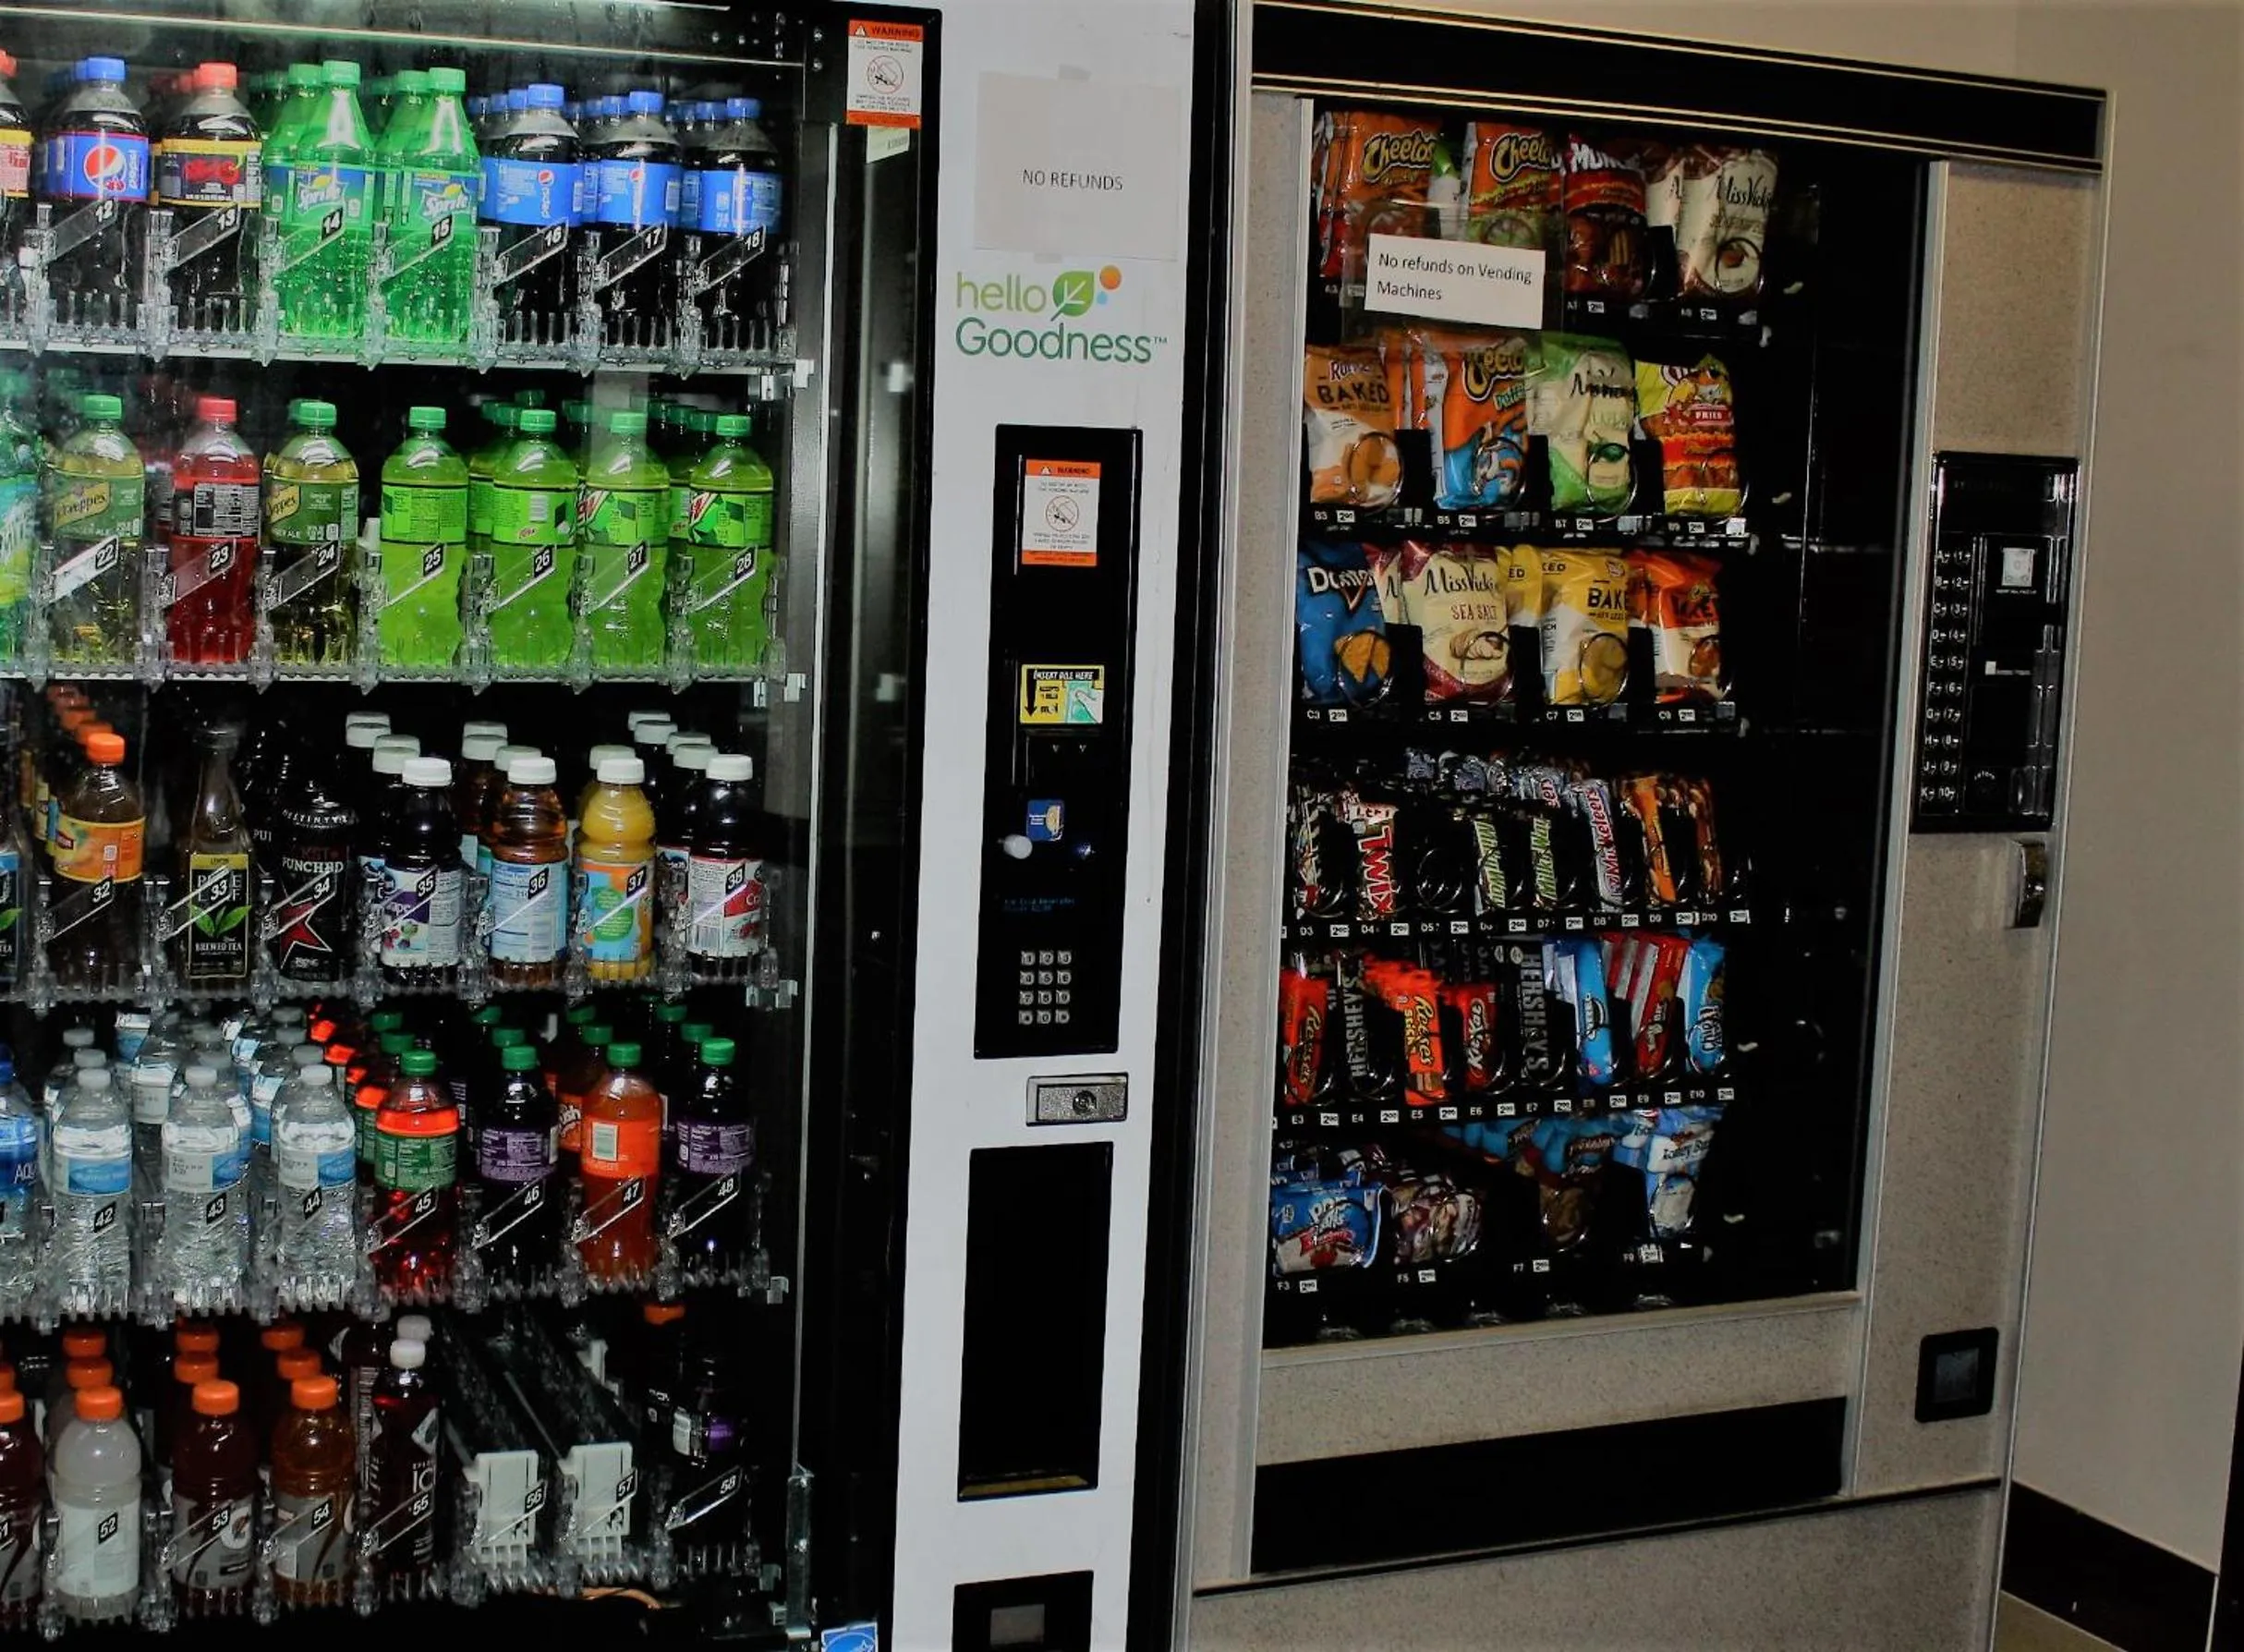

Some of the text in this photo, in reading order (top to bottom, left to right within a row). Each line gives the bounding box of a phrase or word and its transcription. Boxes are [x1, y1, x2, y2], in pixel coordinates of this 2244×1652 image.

[1023, 169, 1123, 191] NO REFUNDS
[96, 200, 113, 222] 12
[217, 211, 237, 231] 13
[323, 213, 341, 233] 14
[433, 220, 450, 240] 15
[545, 228, 561, 247] 16
[645, 231, 661, 249] 17
[744, 232, 760, 249] 18
[1378, 253, 1533, 285] No refunds on Vending
[956, 272, 1046, 313] hello
[1377, 281, 1442, 300] Machines
[955, 317, 1152, 364] Goodness
[1317, 382, 1389, 404] BAKED
[96, 544, 113, 566] 22
[212, 547, 229, 565] 23
[318, 547, 334, 565] 24
[426, 552, 441, 571] 25
[536, 553, 551, 572] 26
[630, 549, 645, 569] 27
[736, 553, 753, 573] 28
[1451, 604, 1498, 620] SEA SALT
[1033, 670, 1057, 680] INSERT
[1075, 672, 1094, 680] HERE
[282, 856, 346, 874] PUNCHED
[1357, 825, 1395, 915] TWIX
[197, 874, 243, 888] PE
[314, 878, 331, 899] 34
[418, 875, 434, 897] 35
[530, 870, 547, 891] 36
[629, 870, 644, 891] 37
[727, 869, 743, 890] 38
[93, 881, 111, 903] 32
[211, 879, 228, 901] 33
[1361, 925, 1374, 934] D4
[1522, 954, 1549, 1070] HERSHEY'S
[1352, 1113, 1365, 1124] E4
[1412, 1110, 1424, 1119] E5
[1470, 1107, 1483, 1116] E6
[524, 1185, 540, 1206] 46
[624, 1184, 639, 1202] 47
[718, 1177, 734, 1196] 48
[208, 1198, 225, 1217] 43
[305, 1192, 321, 1211] 44
[415, 1194, 431, 1214] 45
[95, 1207, 114, 1227] 42
[1513, 1264, 1523, 1273] F7
[1278, 1282, 1290, 1291] F3
[618, 1478, 634, 1497] 57
[719, 1476, 735, 1495] 58
[412, 1493, 429, 1515] 55
[527, 1488, 542, 1507] 56
[212, 1512, 228, 1531] 53
[313, 1507, 329, 1525] 54
[100, 1515, 116, 1538] 52
